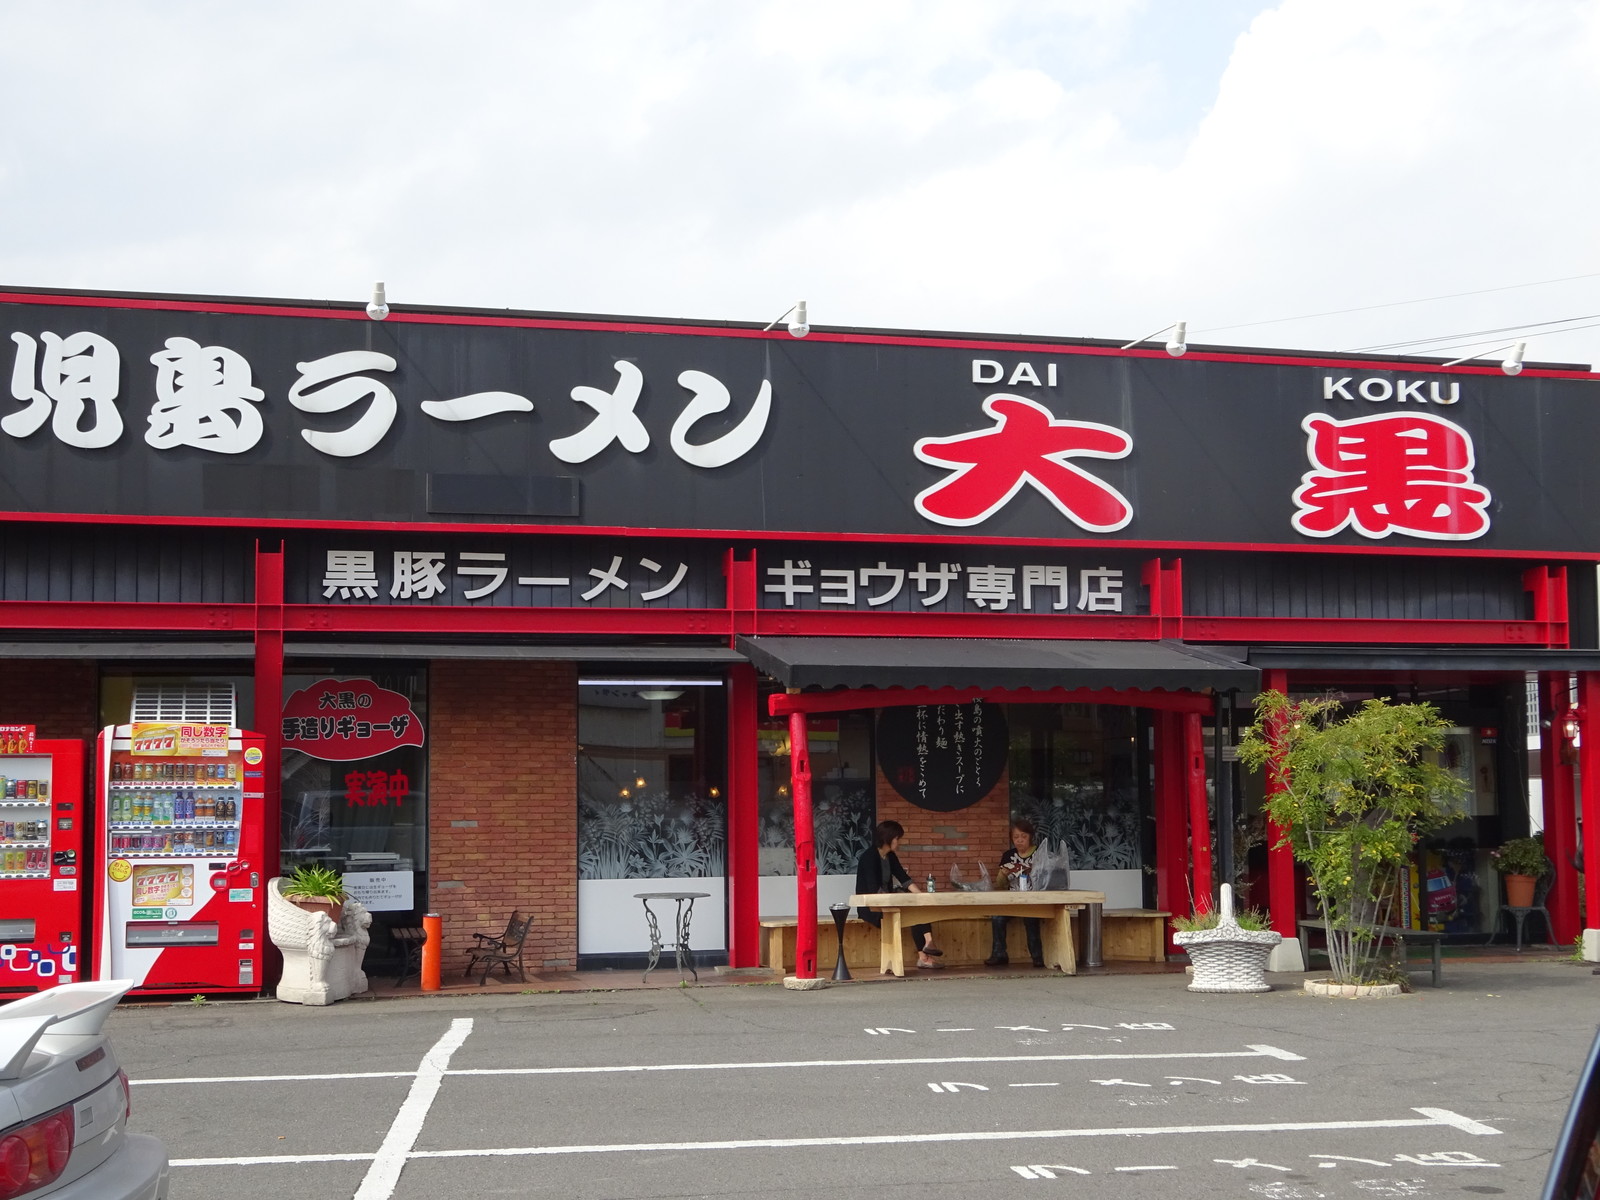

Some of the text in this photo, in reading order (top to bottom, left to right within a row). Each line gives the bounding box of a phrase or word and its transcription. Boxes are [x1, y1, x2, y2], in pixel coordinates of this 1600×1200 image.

[972, 359, 1460, 405] DAI KOKU
[913, 393, 1492, 540] 大 黒
[322, 550, 1123, 612] 黒豚ラーメン ギョウザ専門店
[319, 691, 373, 710] 大黒の
[134, 737, 174, 751] 7777
[181, 726, 226, 738] 同じ数字
[282, 714, 410, 741] 手造りギョーザ
[953, 704, 966, 794] 出す熱きスープに
[344, 769, 409, 807] 実演中
